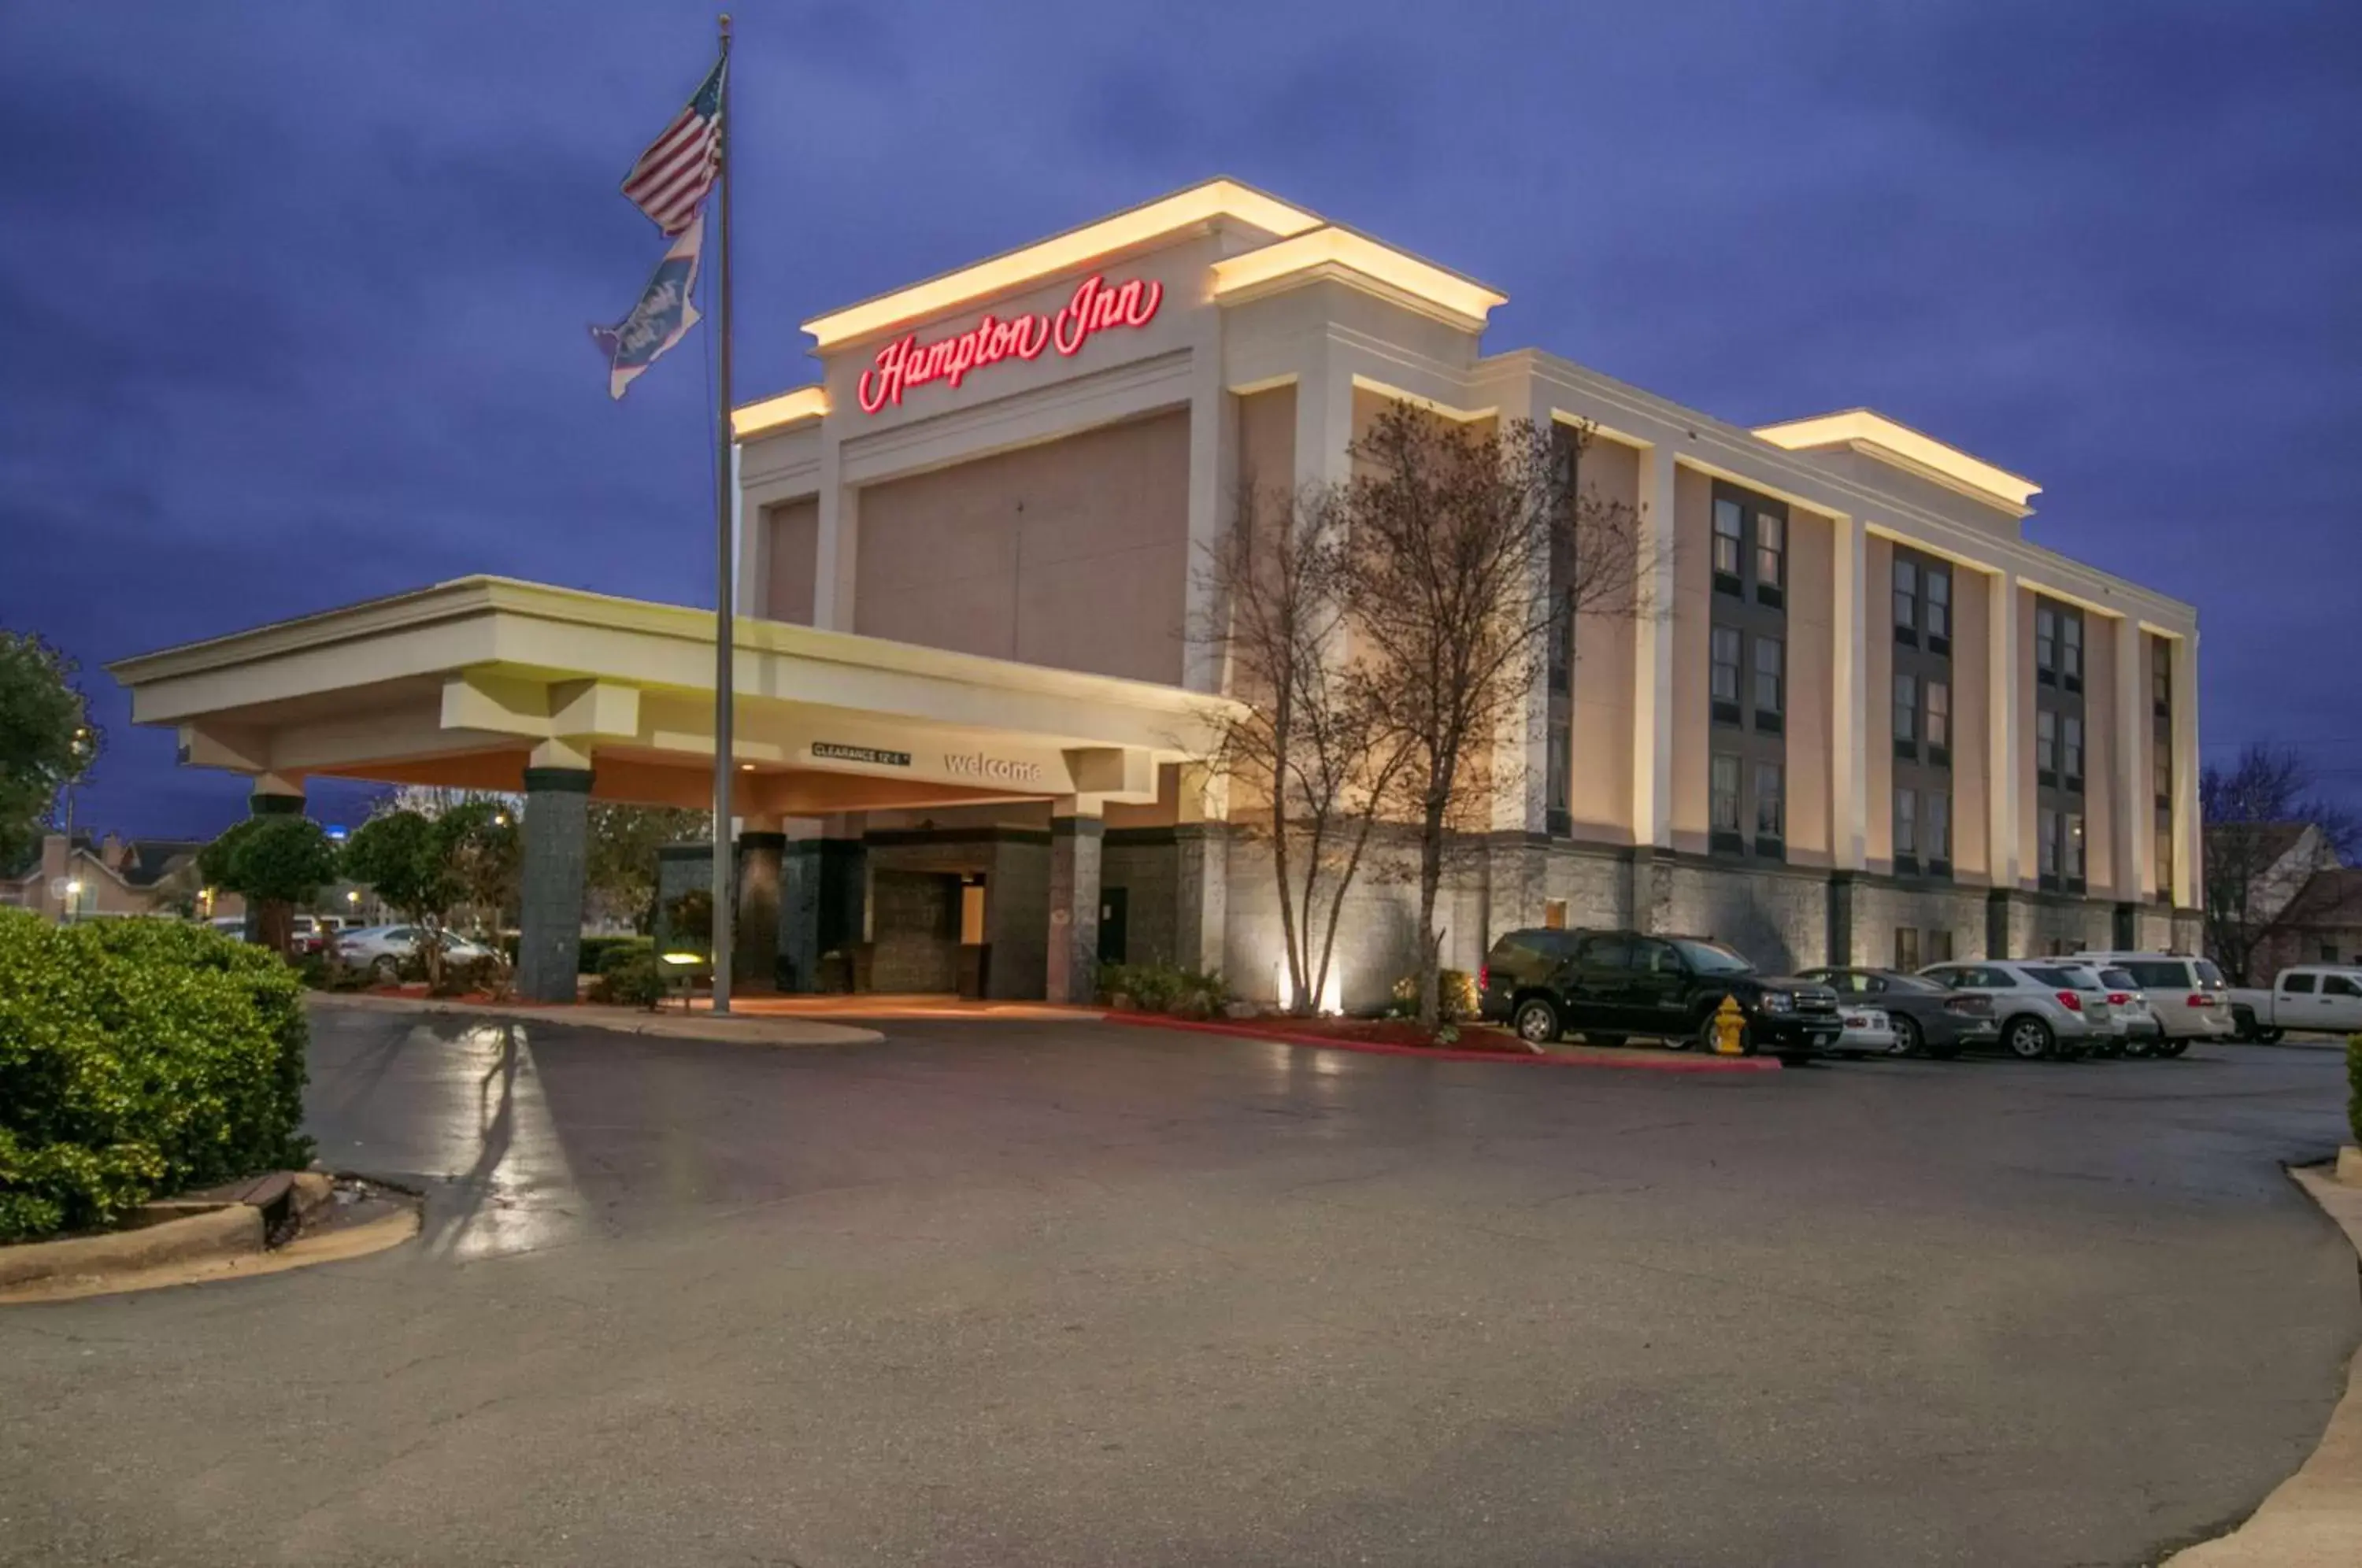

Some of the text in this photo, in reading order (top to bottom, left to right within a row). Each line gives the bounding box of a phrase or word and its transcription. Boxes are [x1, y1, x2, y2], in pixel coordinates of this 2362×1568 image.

[857, 276, 1164, 415] Hampton Inn
[814, 744, 876, 761] CLEARANCE
